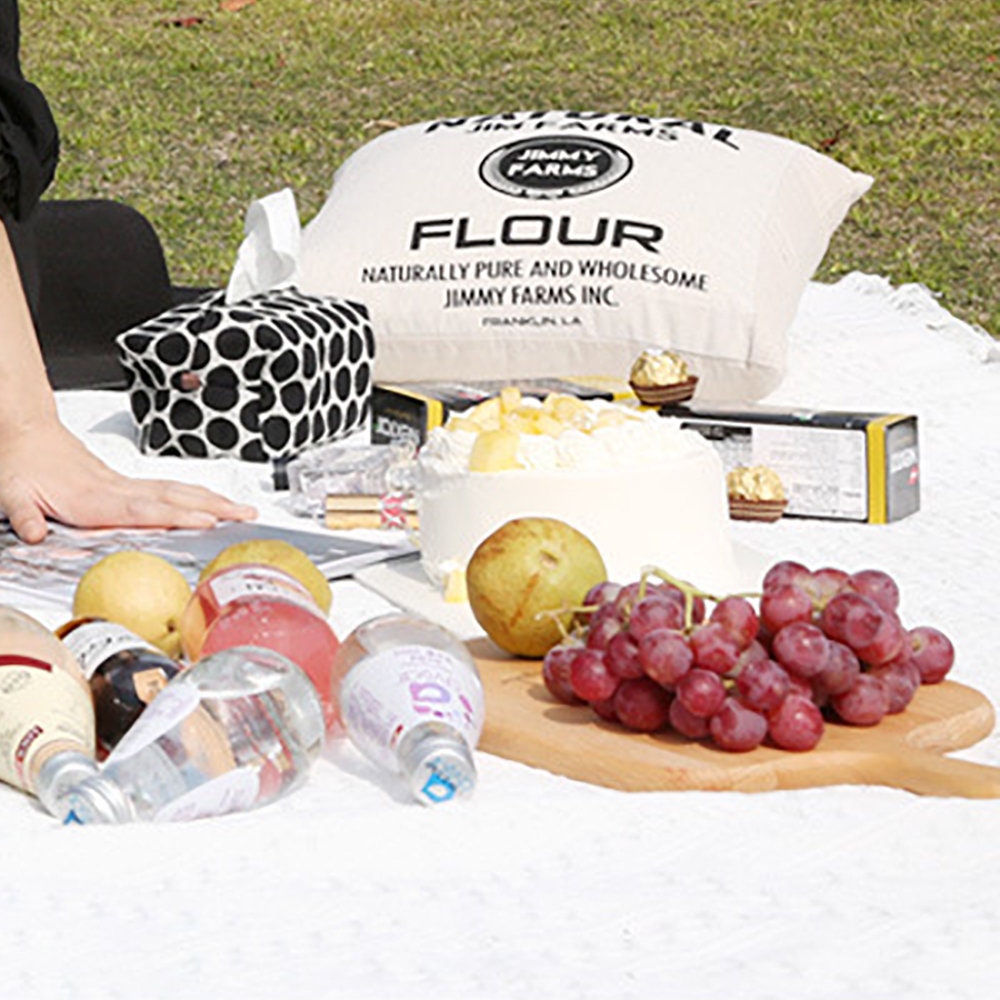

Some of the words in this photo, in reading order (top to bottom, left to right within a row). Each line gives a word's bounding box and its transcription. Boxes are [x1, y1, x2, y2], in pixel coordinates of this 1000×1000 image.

[517, 149, 600, 161] JIMMY
[507, 162, 597, 178] FARMS
[410, 215, 664, 253] FLOUR
[361, 262, 470, 283] NATURALLY
[474, 259, 523, 280] PURE
[529, 259, 573, 278] AND
[578, 259, 709, 291] WHOLESOME
[444, 286, 506, 308] JIMMY
[511, 284, 576, 306] FARMS
